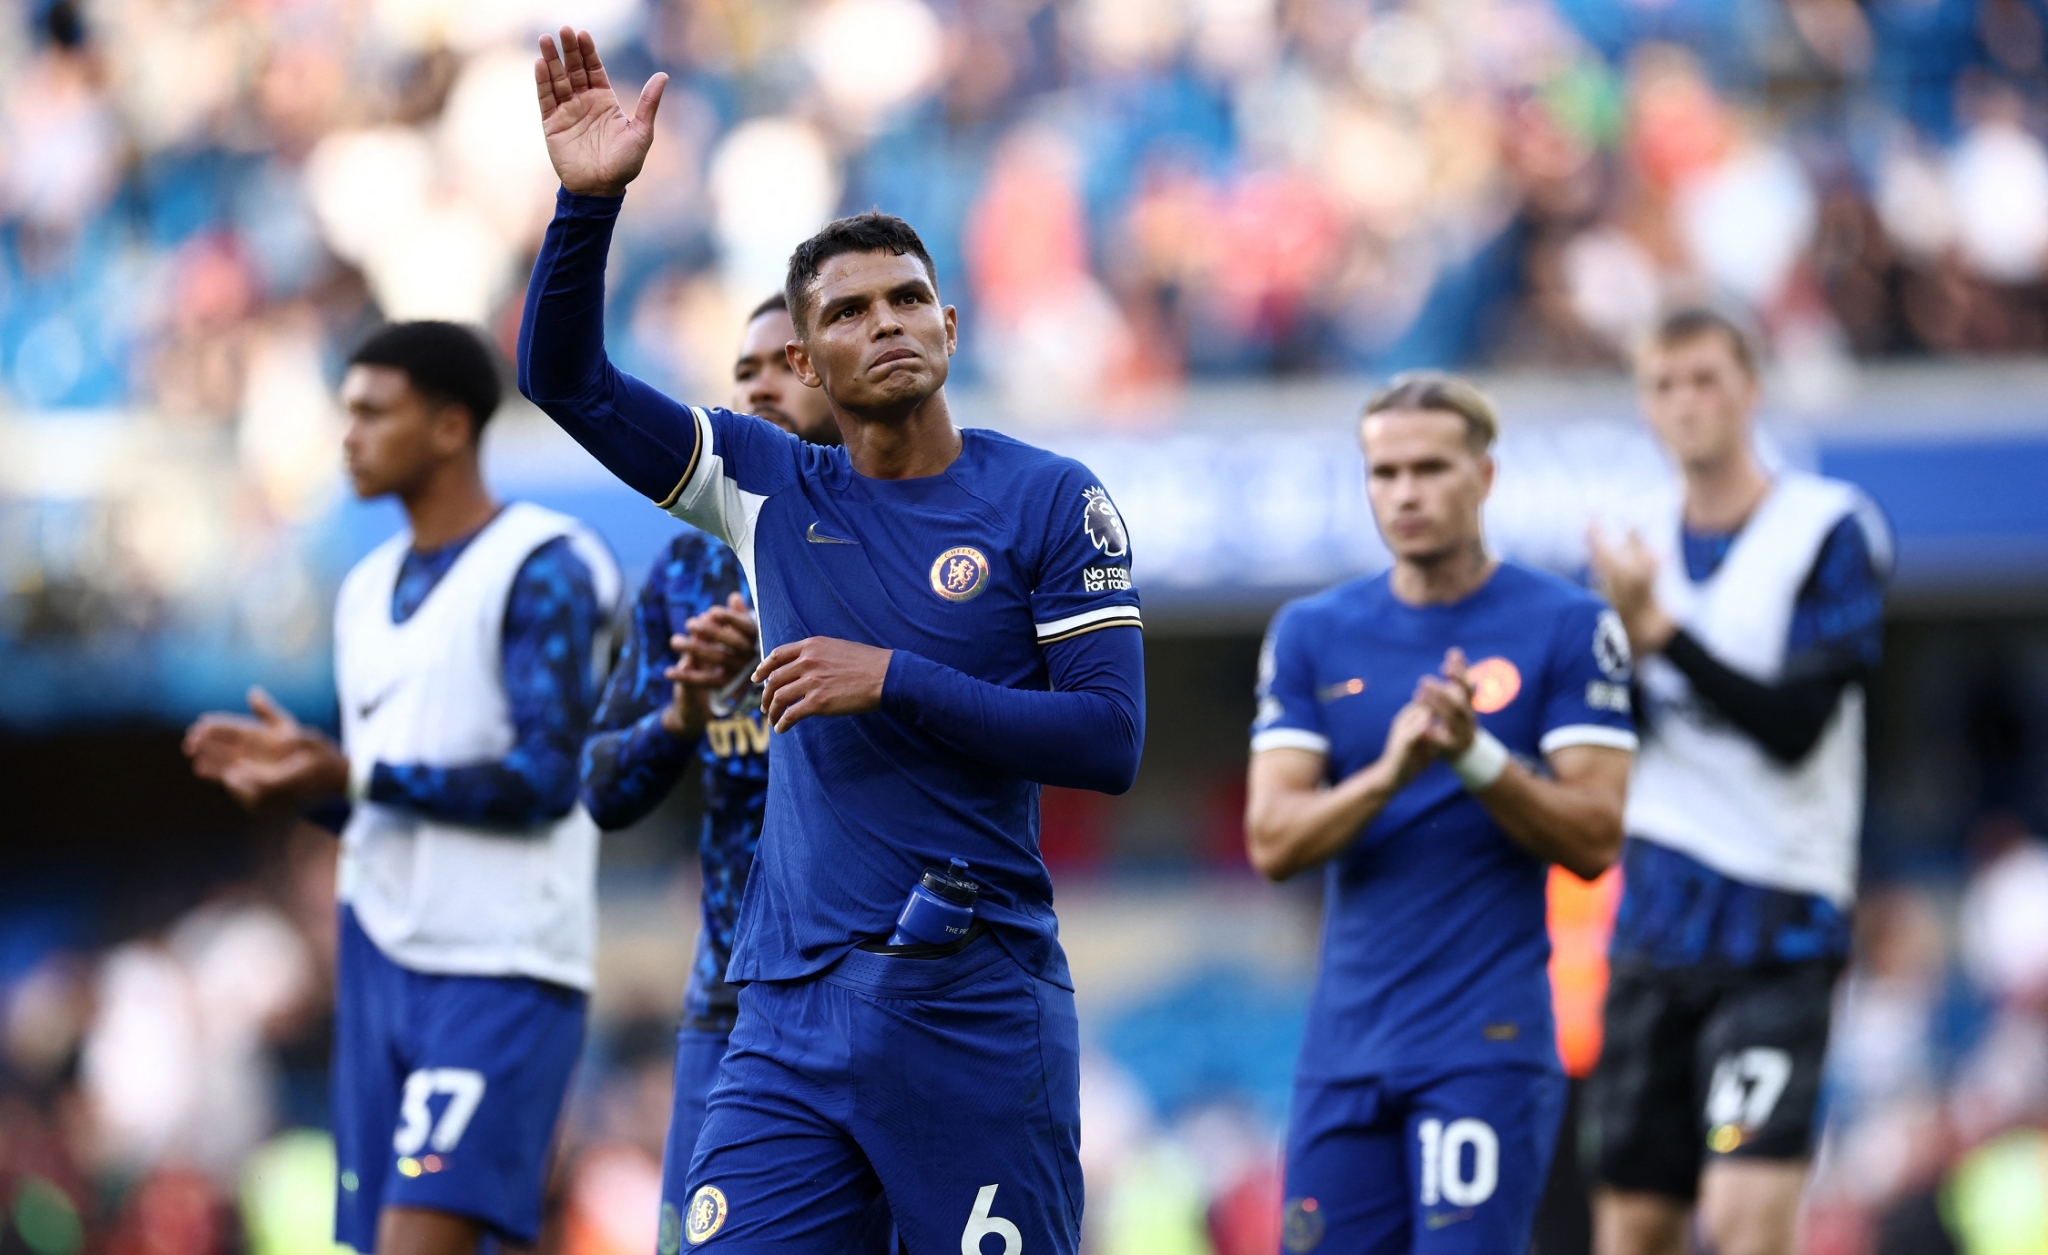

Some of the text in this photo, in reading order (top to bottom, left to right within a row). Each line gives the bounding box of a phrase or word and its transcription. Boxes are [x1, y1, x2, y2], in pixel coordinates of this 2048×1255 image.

[1083, 567, 1105, 581] No
[1084, 580, 1106, 593] For
[945, 925, 959, 935] THE
[1418, 1117, 1499, 1207] 10
[960, 1183, 1023, 1255] 6
